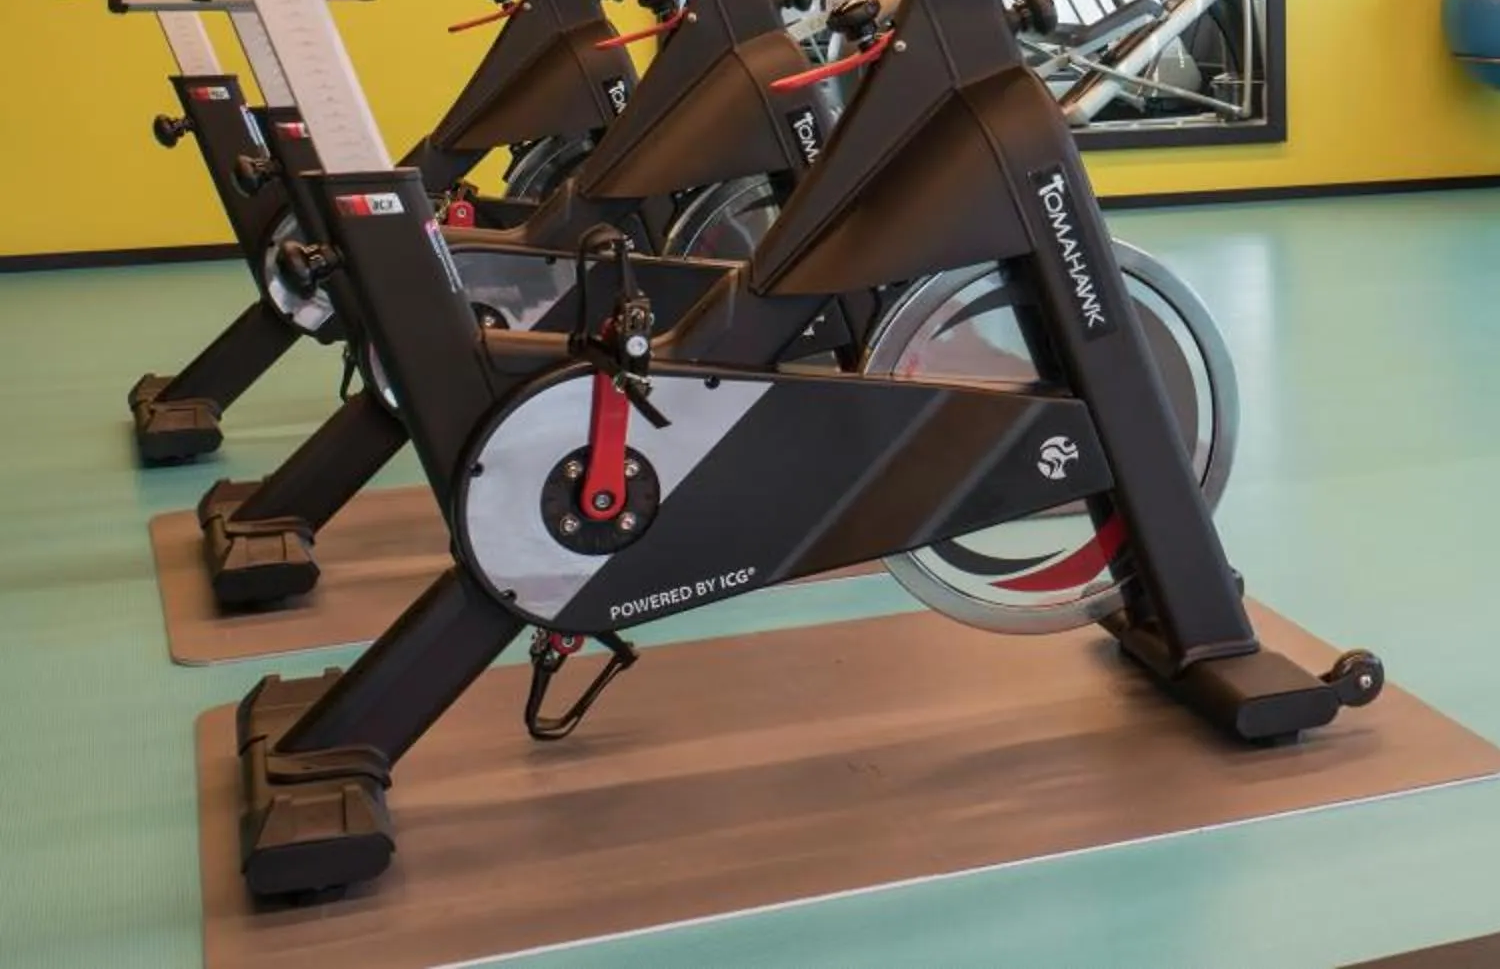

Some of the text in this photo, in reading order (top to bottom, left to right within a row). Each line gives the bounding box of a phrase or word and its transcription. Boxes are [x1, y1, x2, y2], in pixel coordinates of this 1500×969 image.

[793, 111, 821, 164] TOM
[1038, 173, 1105, 329] TOMAHAWK
[609, 585, 692, 620] POWERED
[695, 578, 717, 597] BY
